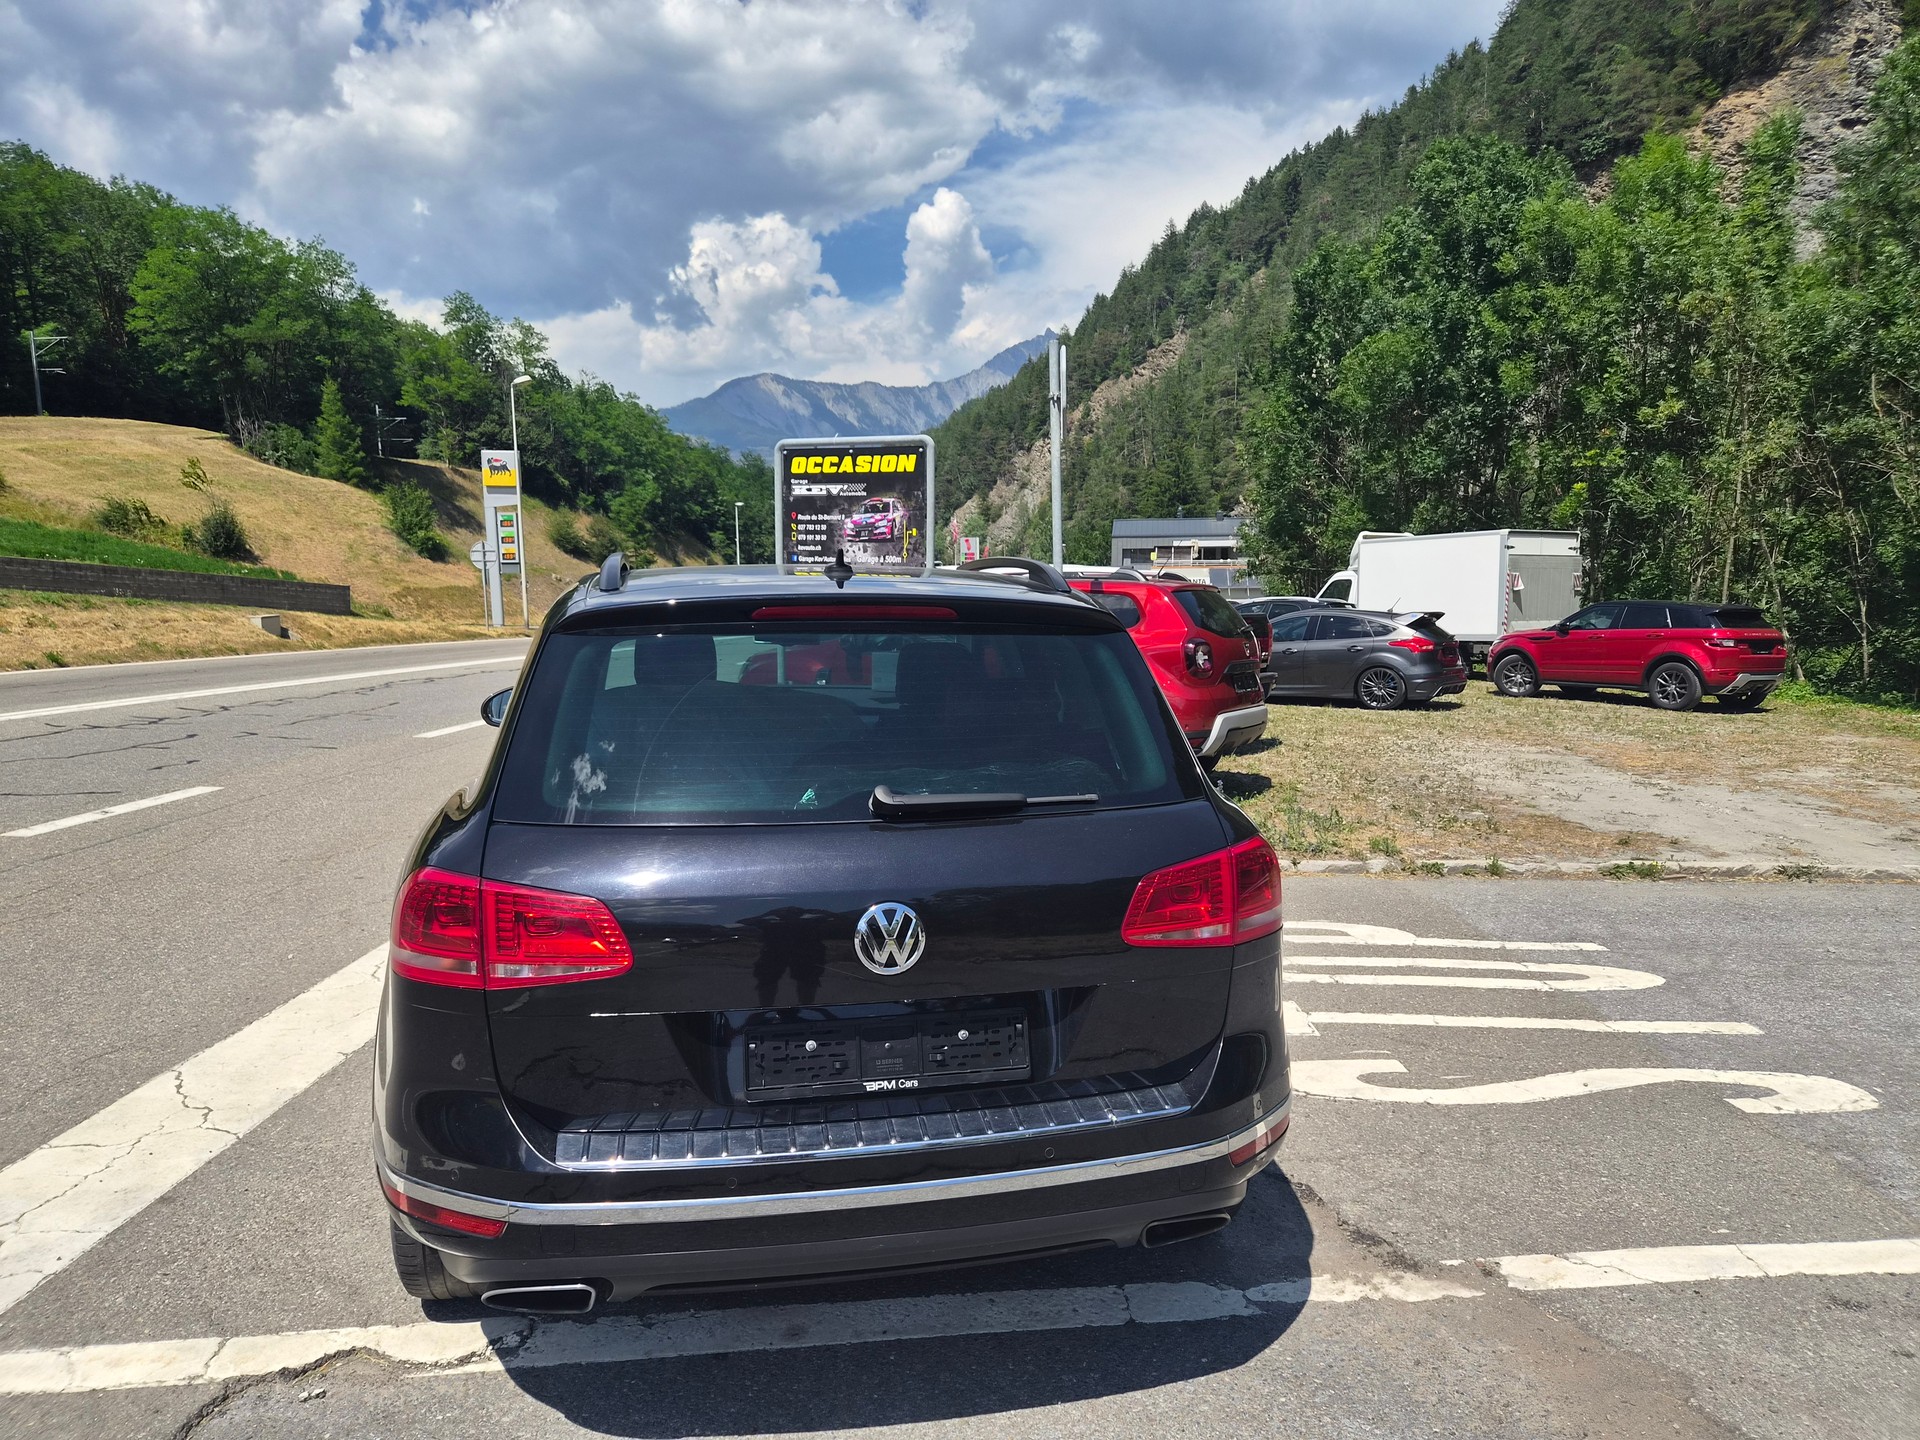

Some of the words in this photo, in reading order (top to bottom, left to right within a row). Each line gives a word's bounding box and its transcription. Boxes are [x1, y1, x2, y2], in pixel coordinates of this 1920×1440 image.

[791, 455, 917, 473] OCCASION
[798, 555, 815, 564] Garage
[857, 555, 879, 564] Garage
[884, 555, 902, 563] 500m
[862, 1079, 896, 1092] BPM
[898, 1079, 919, 1089] Cars
